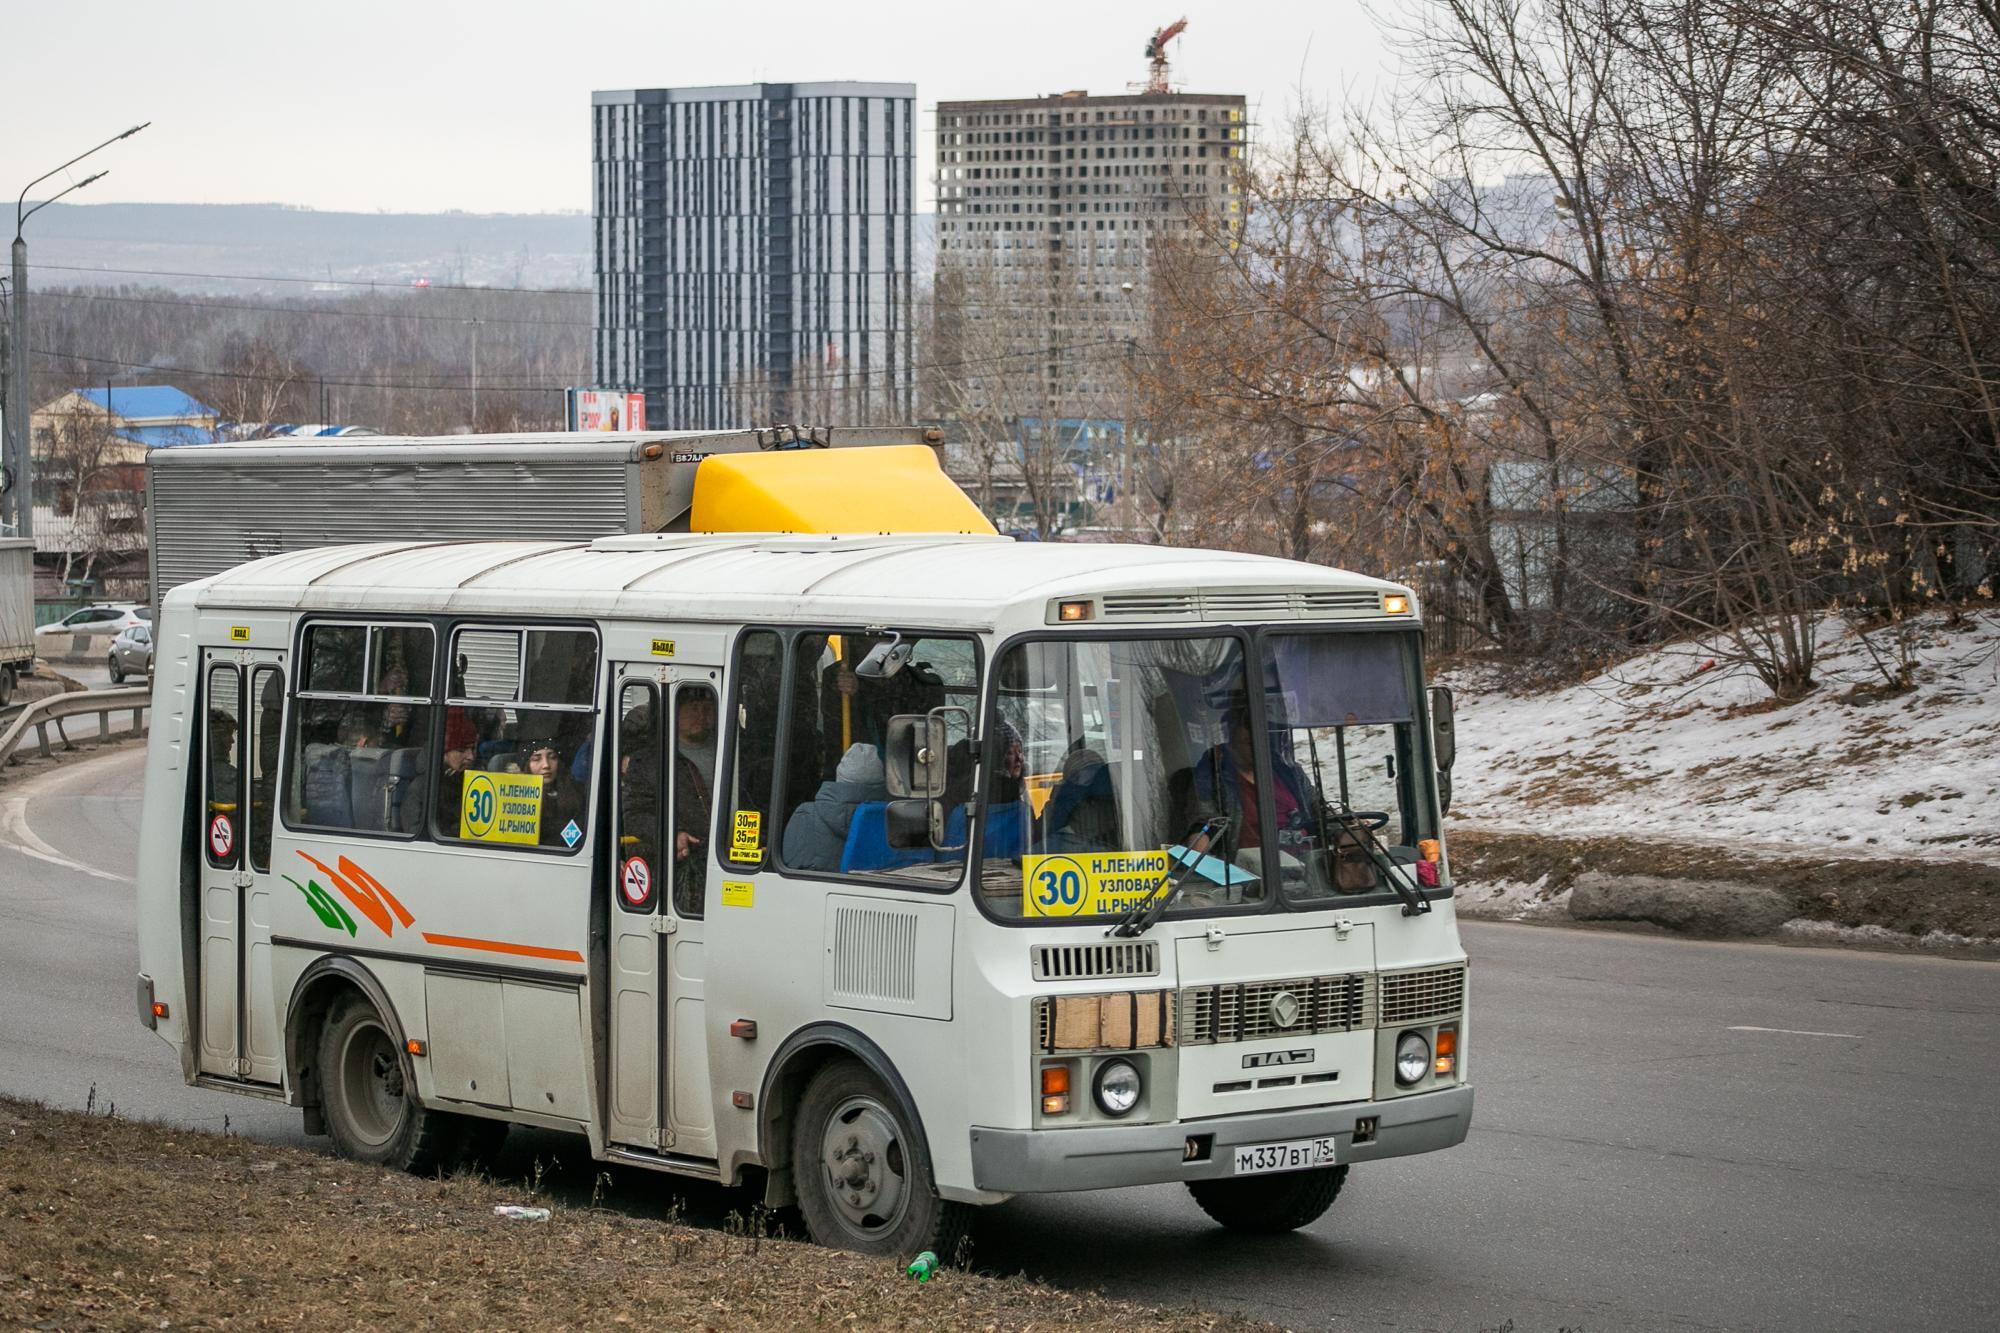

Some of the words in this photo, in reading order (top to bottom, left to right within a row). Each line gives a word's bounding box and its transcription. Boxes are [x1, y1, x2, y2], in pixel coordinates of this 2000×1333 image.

[652, 642, 674, 653] ВЫХОД
[499, 784, 541, 799] Н.ЛЕНИНО
[469, 789, 493, 823] 30
[502, 802, 536, 816] УЗЛОВАЯ
[498, 820, 536, 834] Ц.РЫНОК
[737, 814, 748, 827] 30
[736, 830, 747, 843] 35
[1092, 857, 1165, 873] Н.ЛЕНИНО
[1038, 871, 1080, 905] 30
[1242, 1049, 1315, 1068] ПАЗ
[1315, 1140, 1330, 1157] 75
